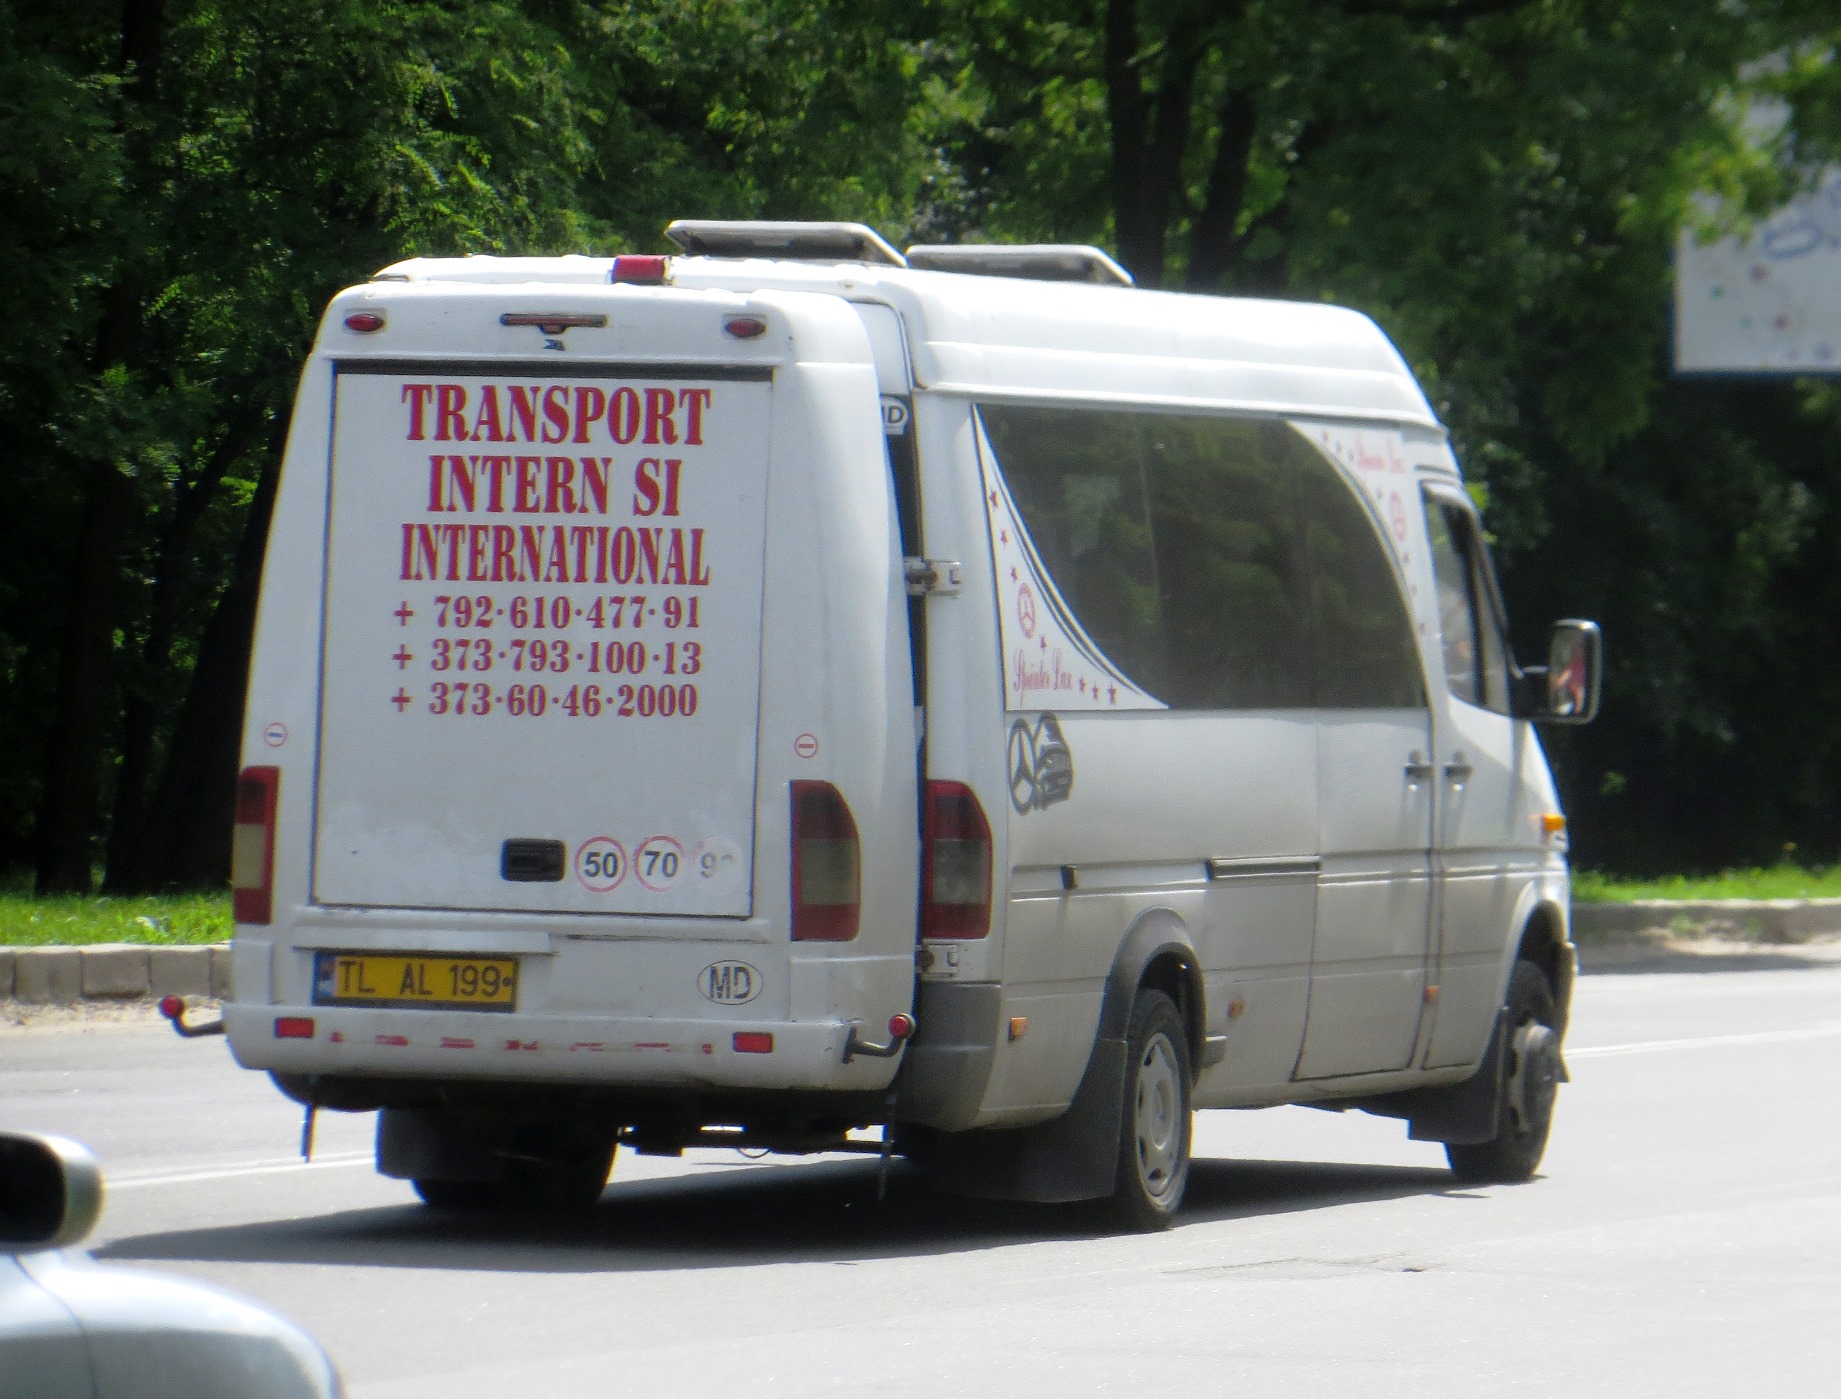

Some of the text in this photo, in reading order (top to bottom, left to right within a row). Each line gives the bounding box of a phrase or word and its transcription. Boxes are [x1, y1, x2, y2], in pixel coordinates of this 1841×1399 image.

[401, 383, 712, 445] TRANSPORT
[427, 455, 684, 517] INTERN SI
[400, 523, 710, 587] INTERNATIONAL
[584, 851, 618, 878] 50
[644, 850, 678, 878] 70
[339, 960, 500, 997] TL AL 199
[709, 966, 751, 999] MD
